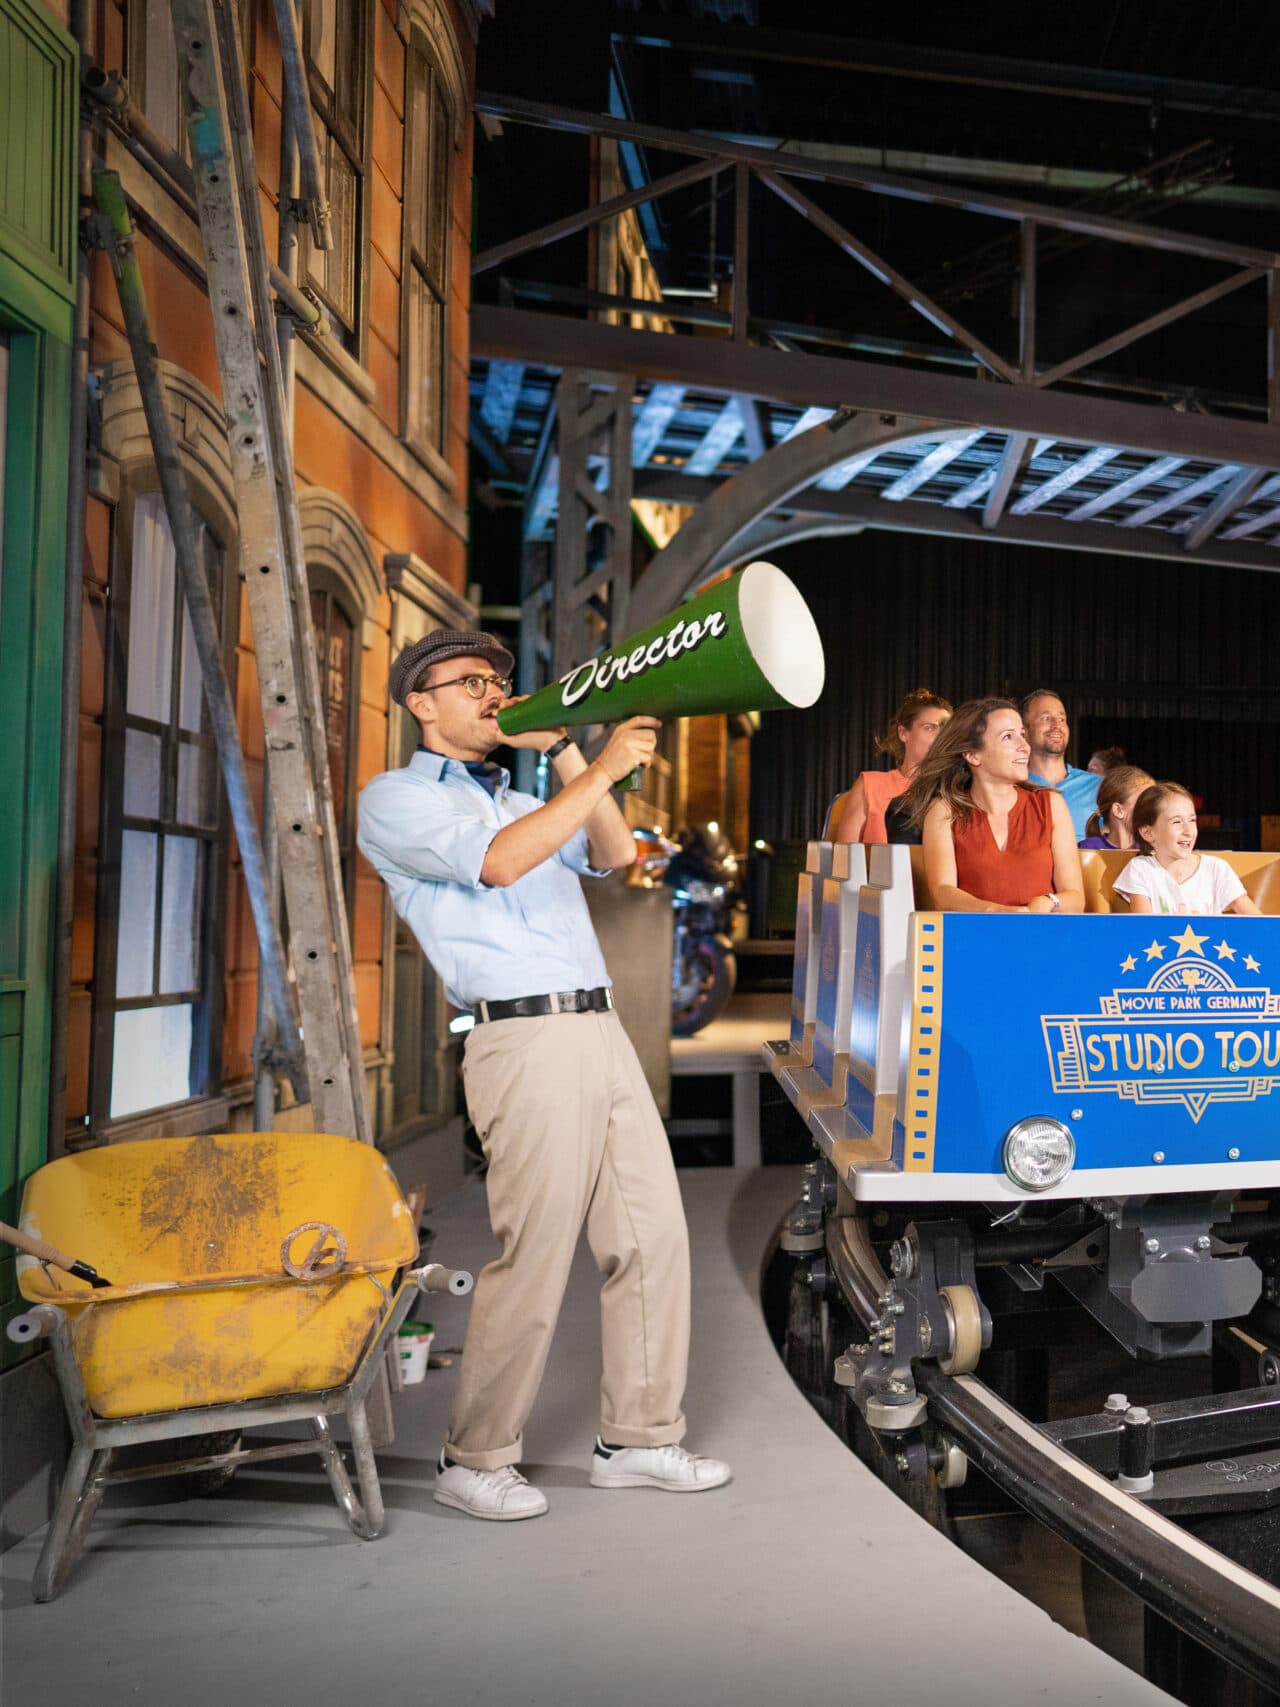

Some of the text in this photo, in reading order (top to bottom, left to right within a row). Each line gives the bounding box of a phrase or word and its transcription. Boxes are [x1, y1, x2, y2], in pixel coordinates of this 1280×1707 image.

[559, 610, 728, 707] Director
[1121, 995, 1265, 1011] MOVIE PARK GERMANY
[1085, 1032, 1205, 1072] STUDIO
